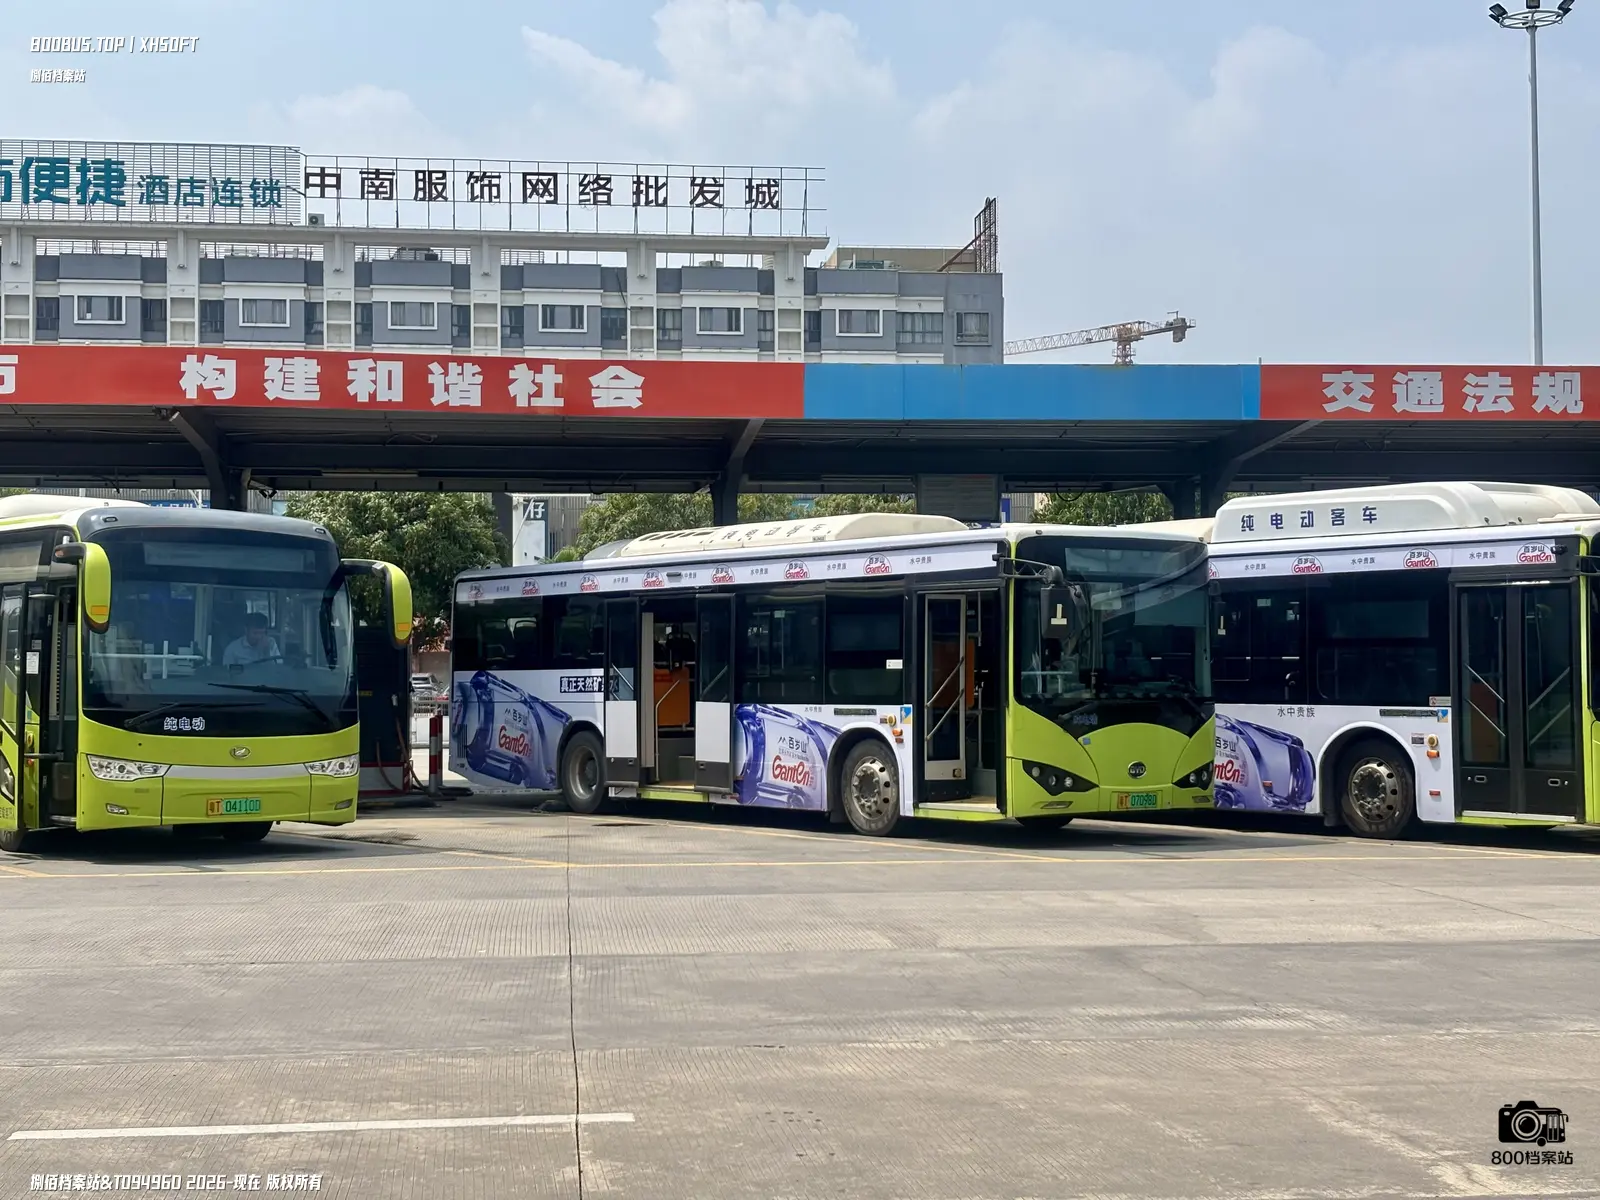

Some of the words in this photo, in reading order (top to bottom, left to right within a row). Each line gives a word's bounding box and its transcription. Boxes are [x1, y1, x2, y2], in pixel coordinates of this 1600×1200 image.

[138, 174, 283, 209] 酒店连锁
[305, 166, 780, 211] 中南服饰网络批发城
[179, 353, 646, 409] 构建和谐社会
[1321, 369, 1585, 415] 交通法规
[1241, 505, 1378, 532] 纯电动客车
[1468, 551, 1496, 560] 水中贵族
[163, 716, 206, 731] 纯电动
[1277, 706, 1316, 718] 水中贵族
